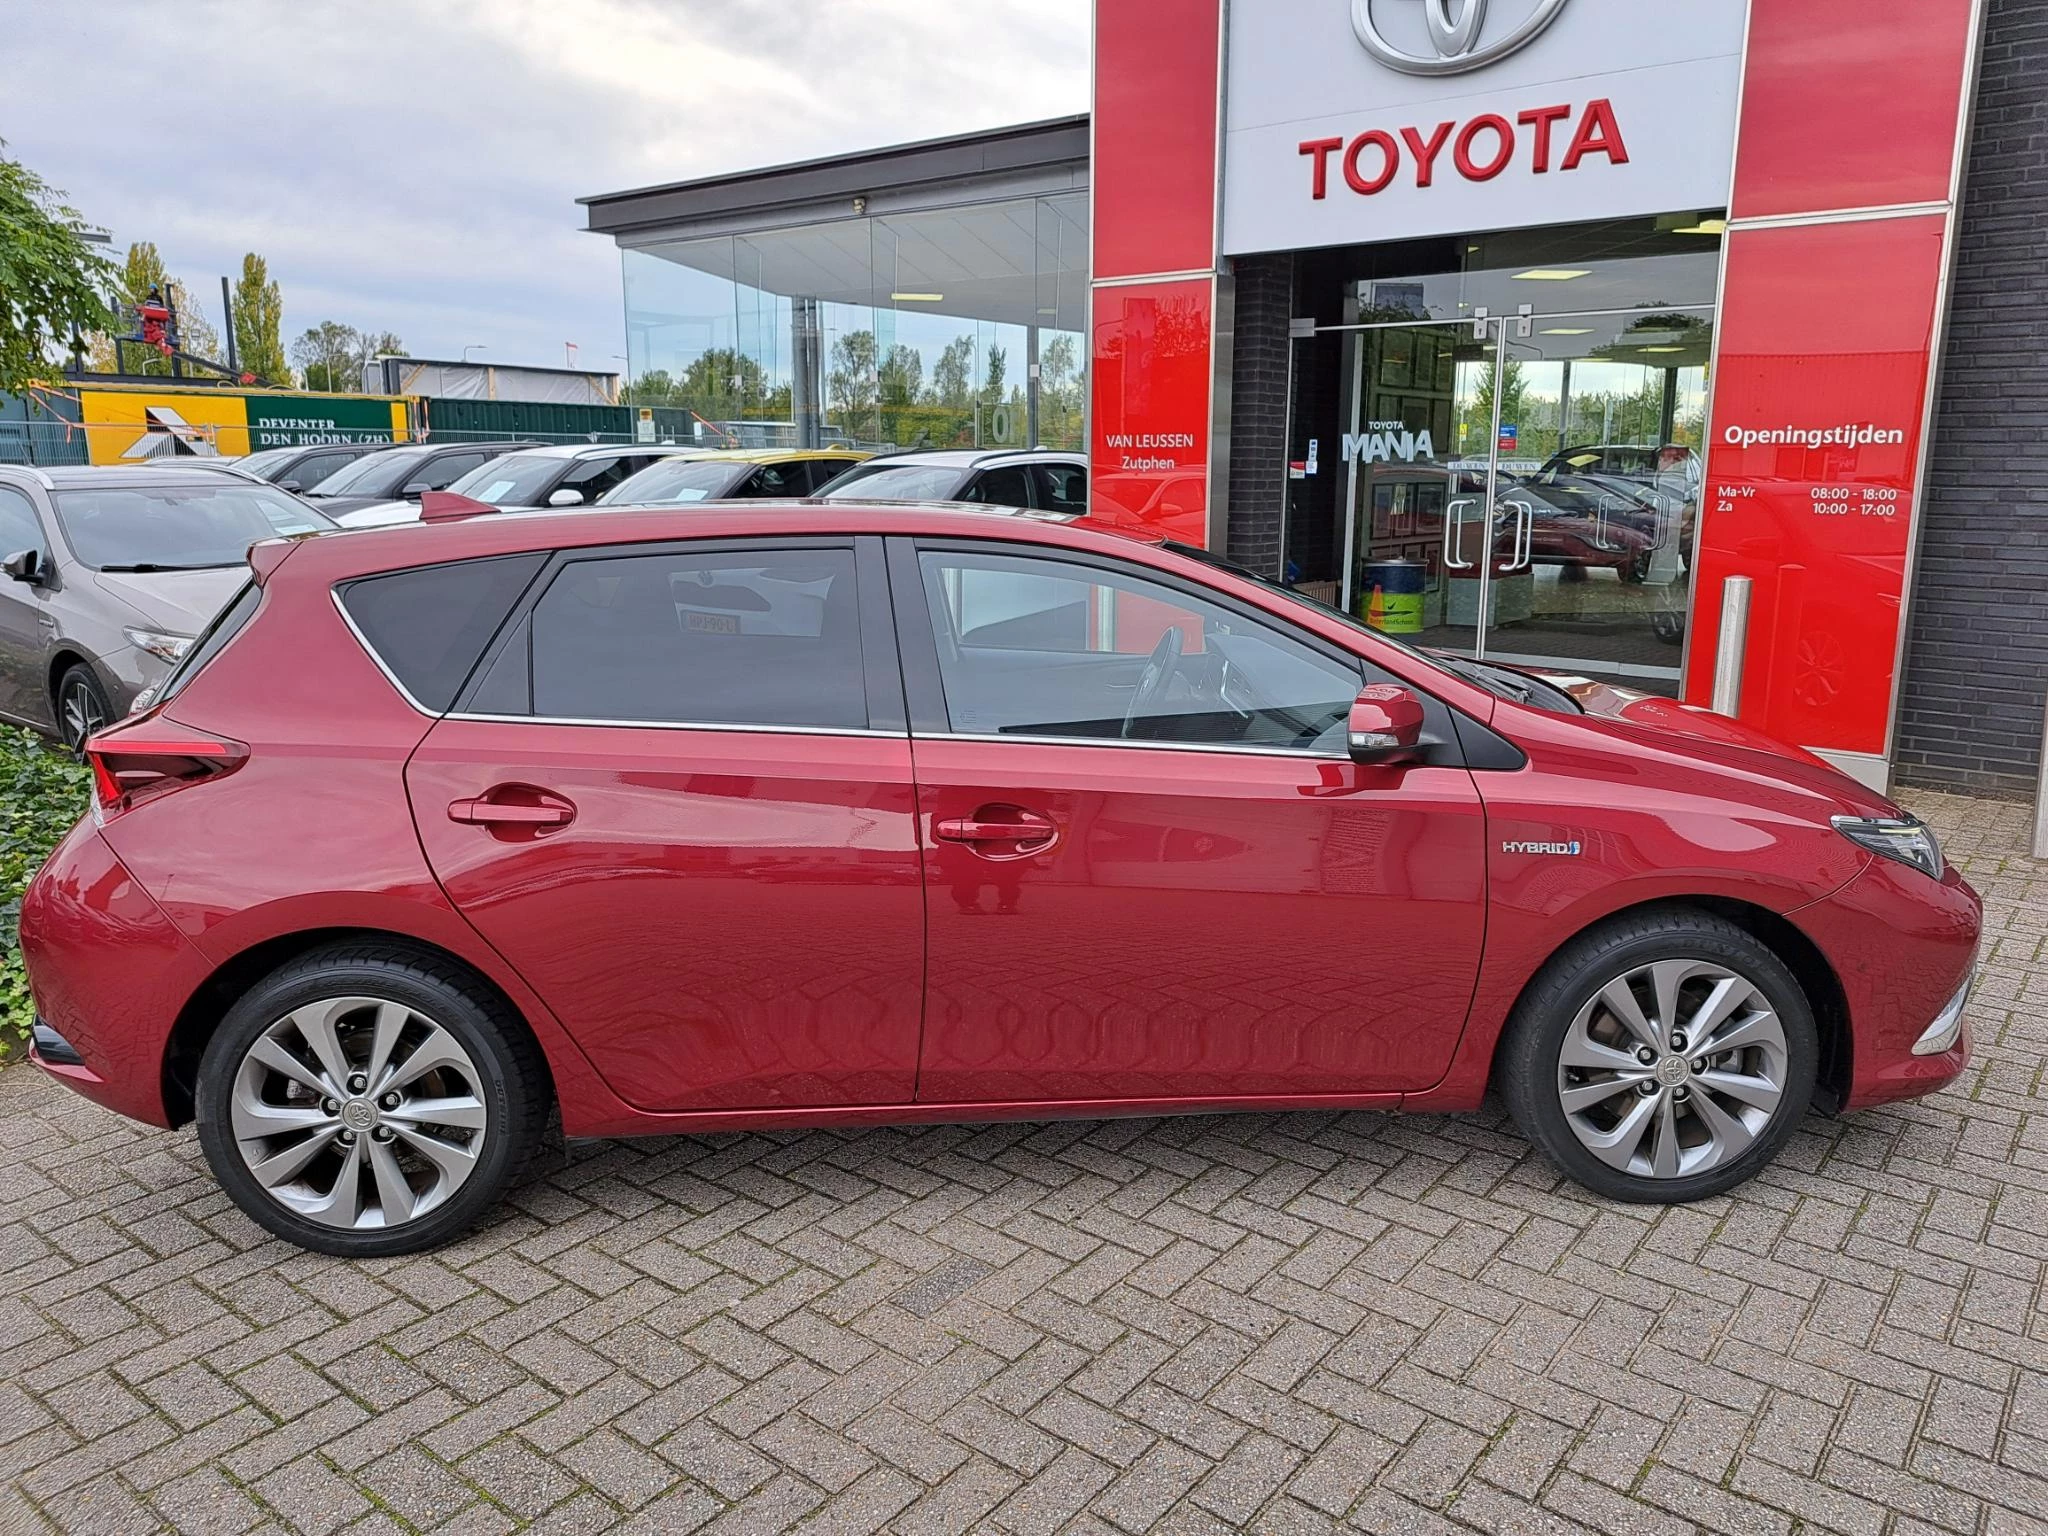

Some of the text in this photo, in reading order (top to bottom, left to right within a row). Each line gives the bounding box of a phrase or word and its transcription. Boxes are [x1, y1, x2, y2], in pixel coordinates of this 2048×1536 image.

[1299, 98, 1630, 200] TOYOTA
[259, 417, 336, 429] DEVENTER
[1368, 421, 1404, 430] TOYOTA
[260, 432, 391, 445] DEN HOORN (ZH)
[1106, 433, 1194, 448] VAN LEUSSEN
[1725, 424, 1904, 449] Openingstijden
[1342, 429, 1434, 464] MANIA
[1121, 455, 1175, 472] Zutphen
[1718, 486, 1756, 498] Ma-Vr
[1811, 487, 1849, 500] 08:00
[1862, 488, 1897, 501] 18:00
[1717, 500, 1733, 512] Za
[1813, 502, 1848, 515] 10:00
[1860, 504, 1895, 516] 17:00
[1502, 841, 1567, 854] HYBRID
